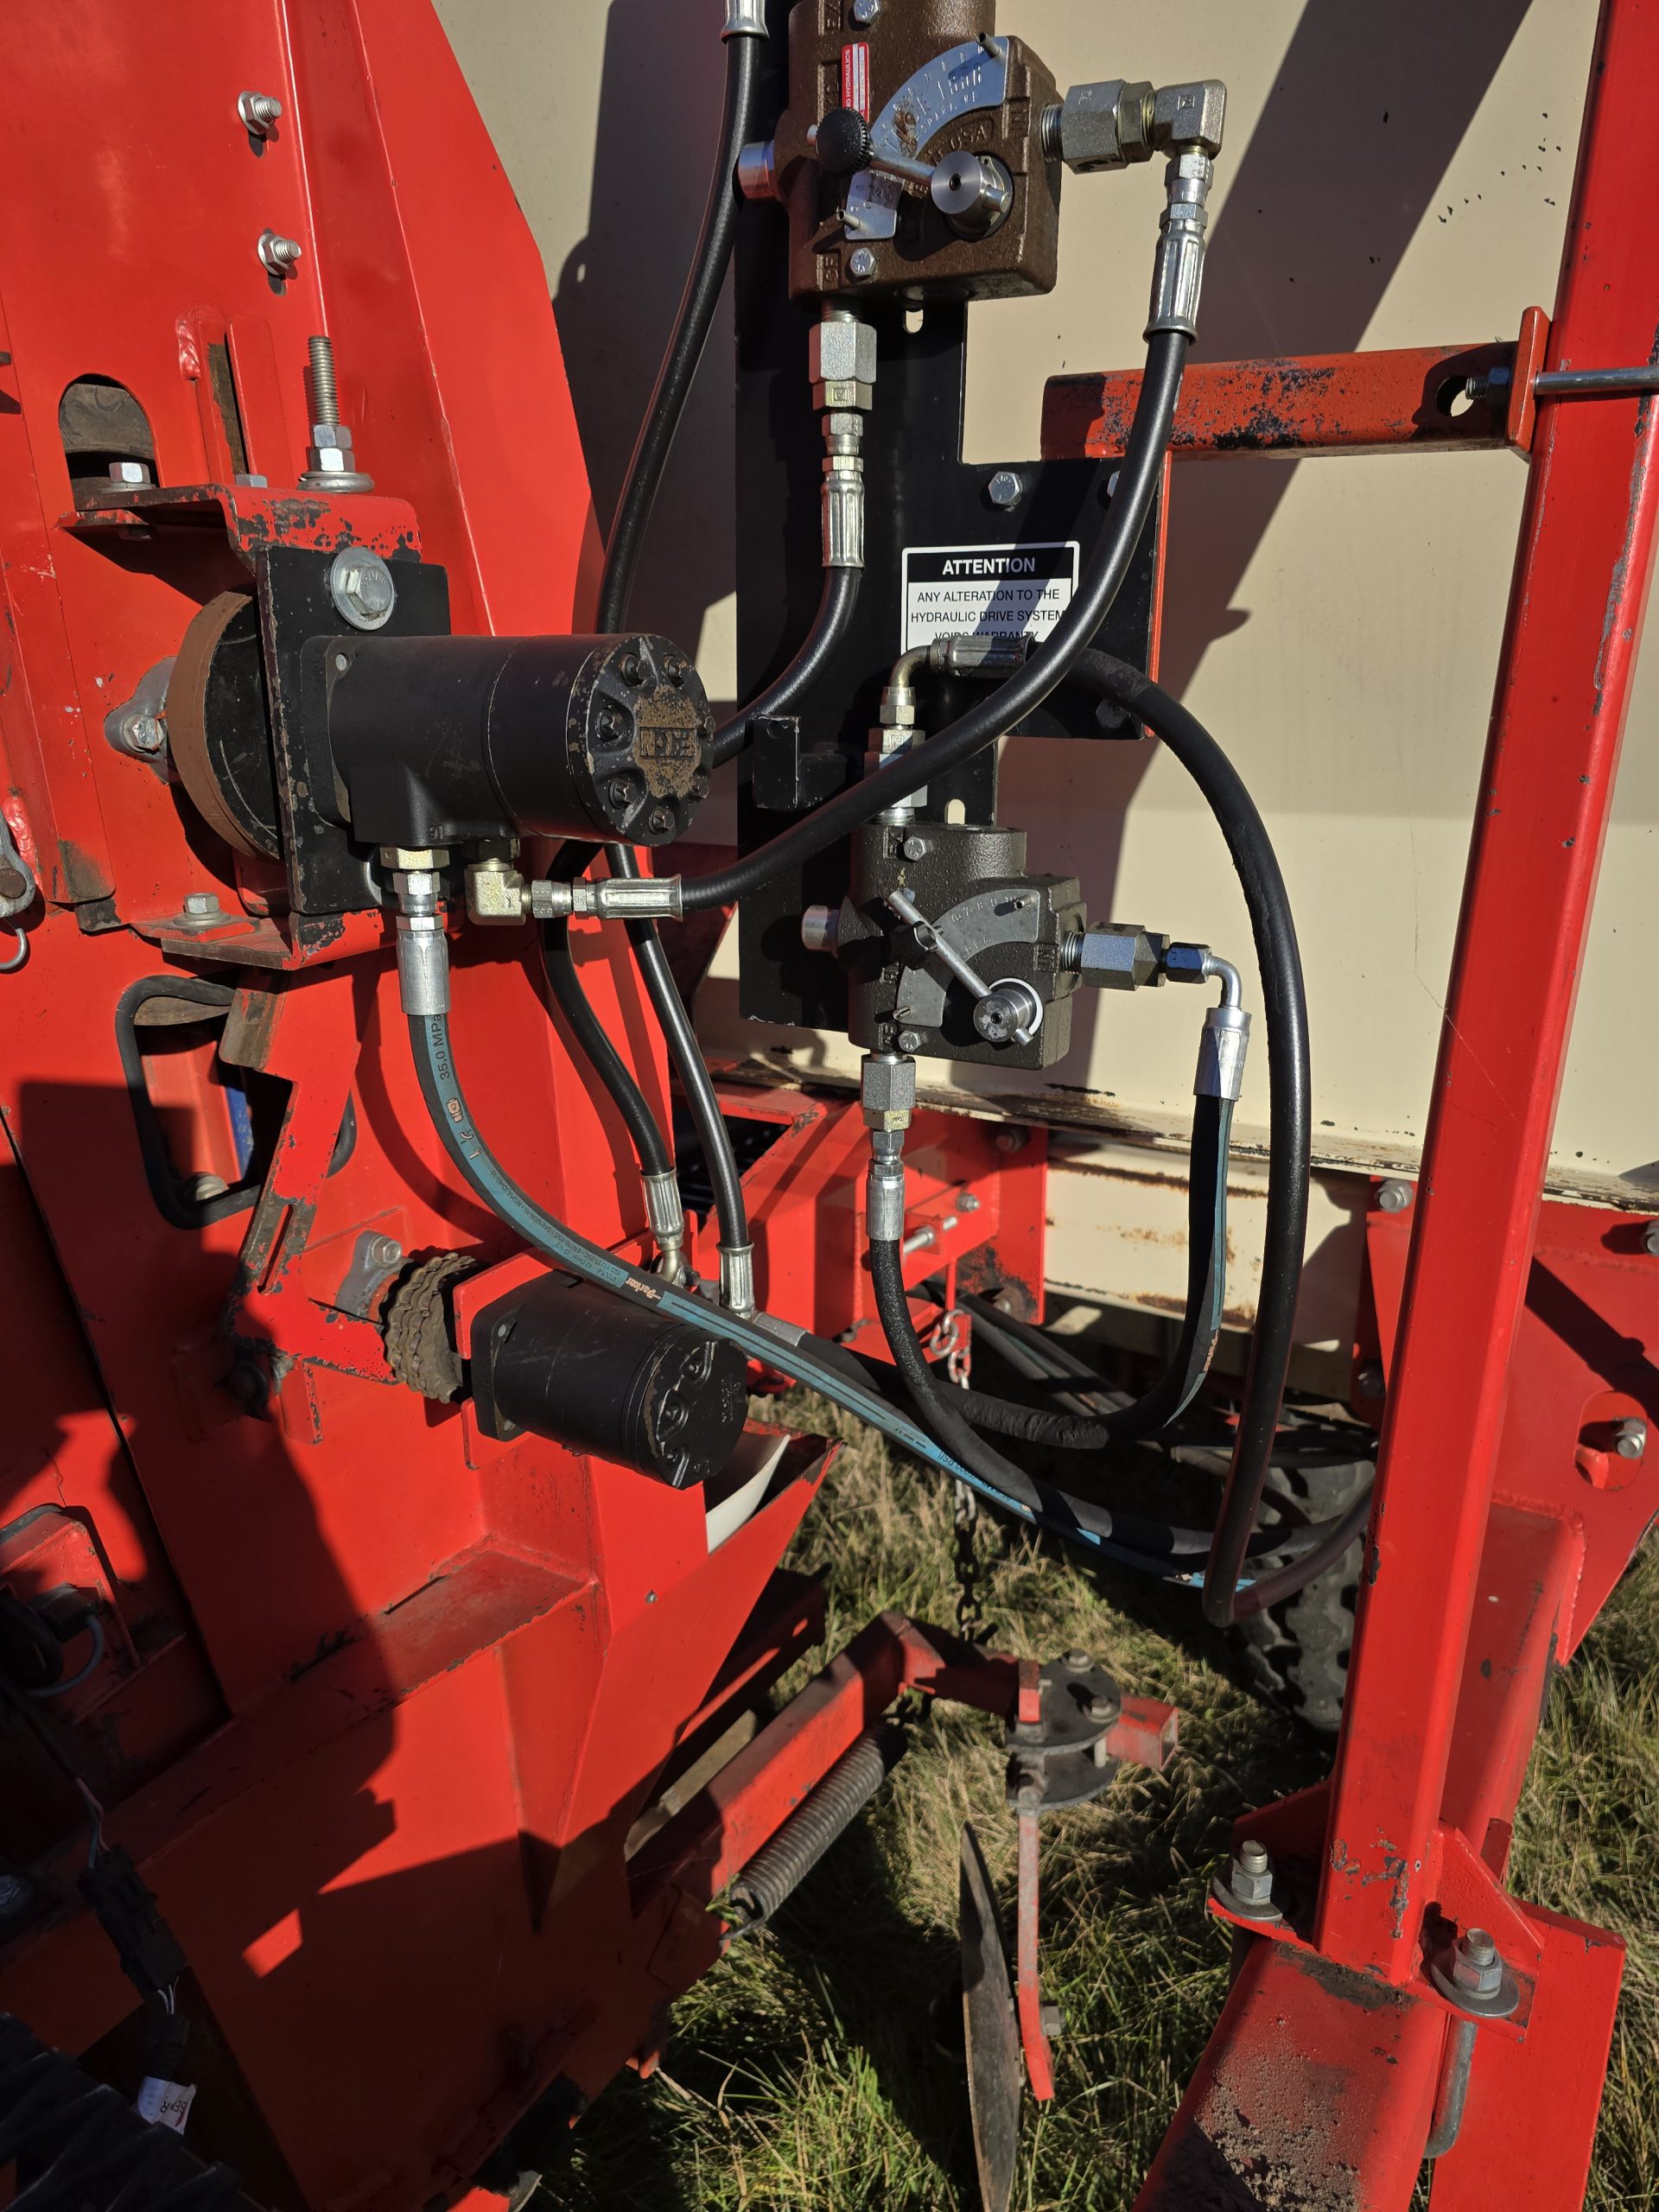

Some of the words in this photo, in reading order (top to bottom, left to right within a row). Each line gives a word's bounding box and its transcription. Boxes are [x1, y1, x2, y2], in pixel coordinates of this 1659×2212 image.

[942, 557, 1035, 575] ATTENTION
[917, 592, 941, 602] ANY
[944, 590, 1014, 602] ALTERATION
[1016, 589, 1033, 600] TO
[1038, 588, 1060, 600] THE
[911, 611, 976, 623] HYDRAULIC
[980, 611, 1014, 622] DRIVE
[431, 1014, 443, 1047] MPa
[625, 1277, 658, 1299] Parker
